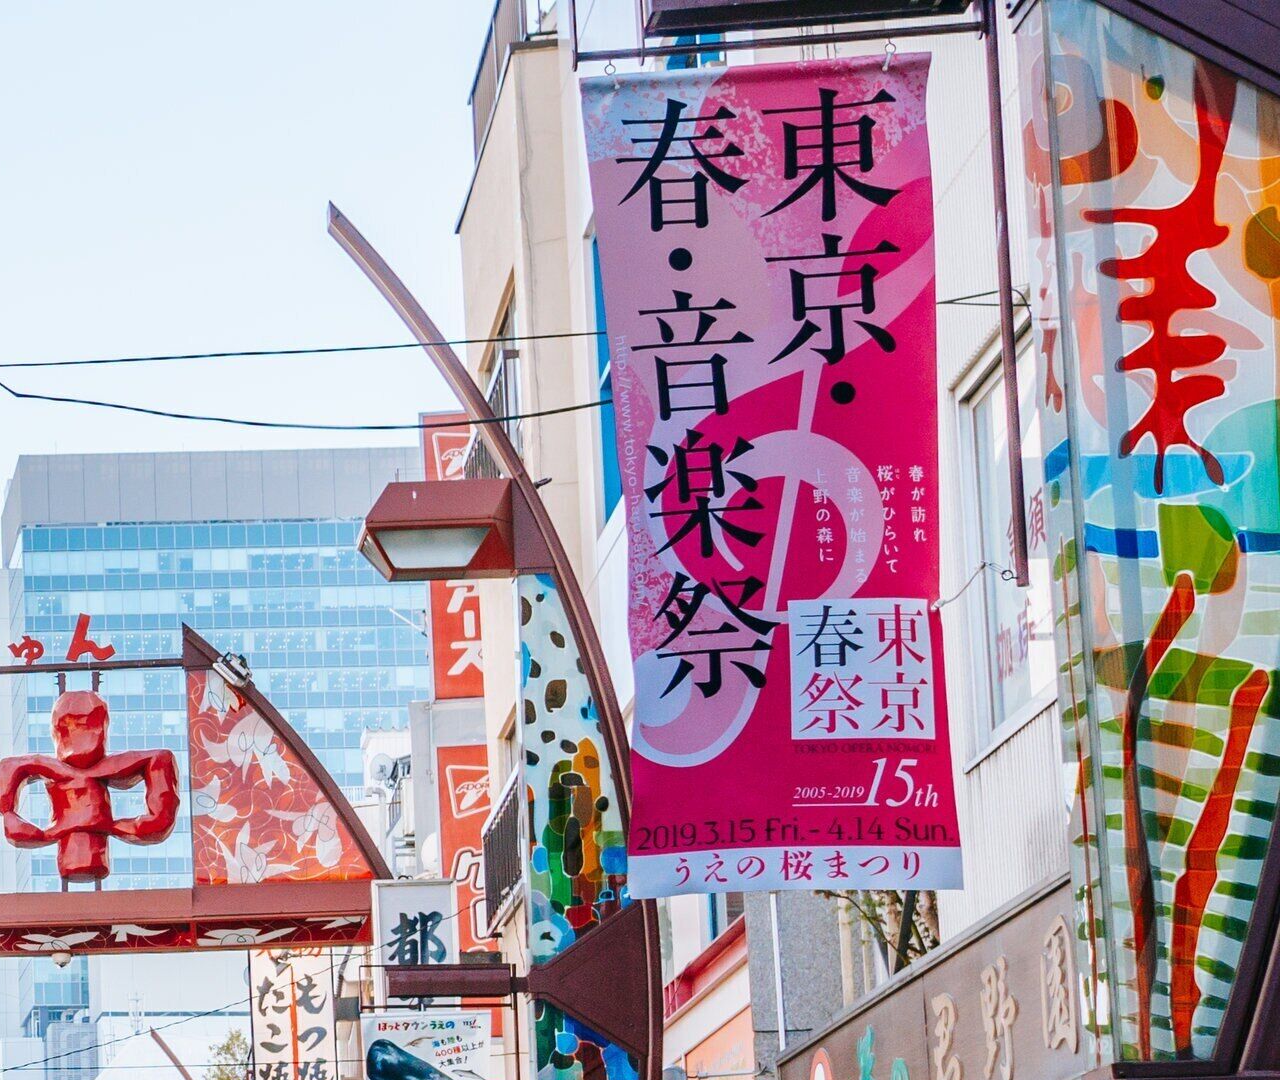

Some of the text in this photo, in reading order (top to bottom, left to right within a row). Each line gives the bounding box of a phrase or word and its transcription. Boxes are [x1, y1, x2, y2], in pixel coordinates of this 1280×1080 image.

[813, 468, 834, 562] 上野の森に
[877, 465, 898, 573] 桜がひらいて
[909, 466, 927, 542] 春が訪れ
[793, 758, 940, 807] 2005-2019 15th
[637, 818, 755, 850] 2019.3.15
[827, 817, 884, 841] 4.14
[895, 817, 954, 842] Sun.
[673, 850, 922, 886] うえの桜まつり
